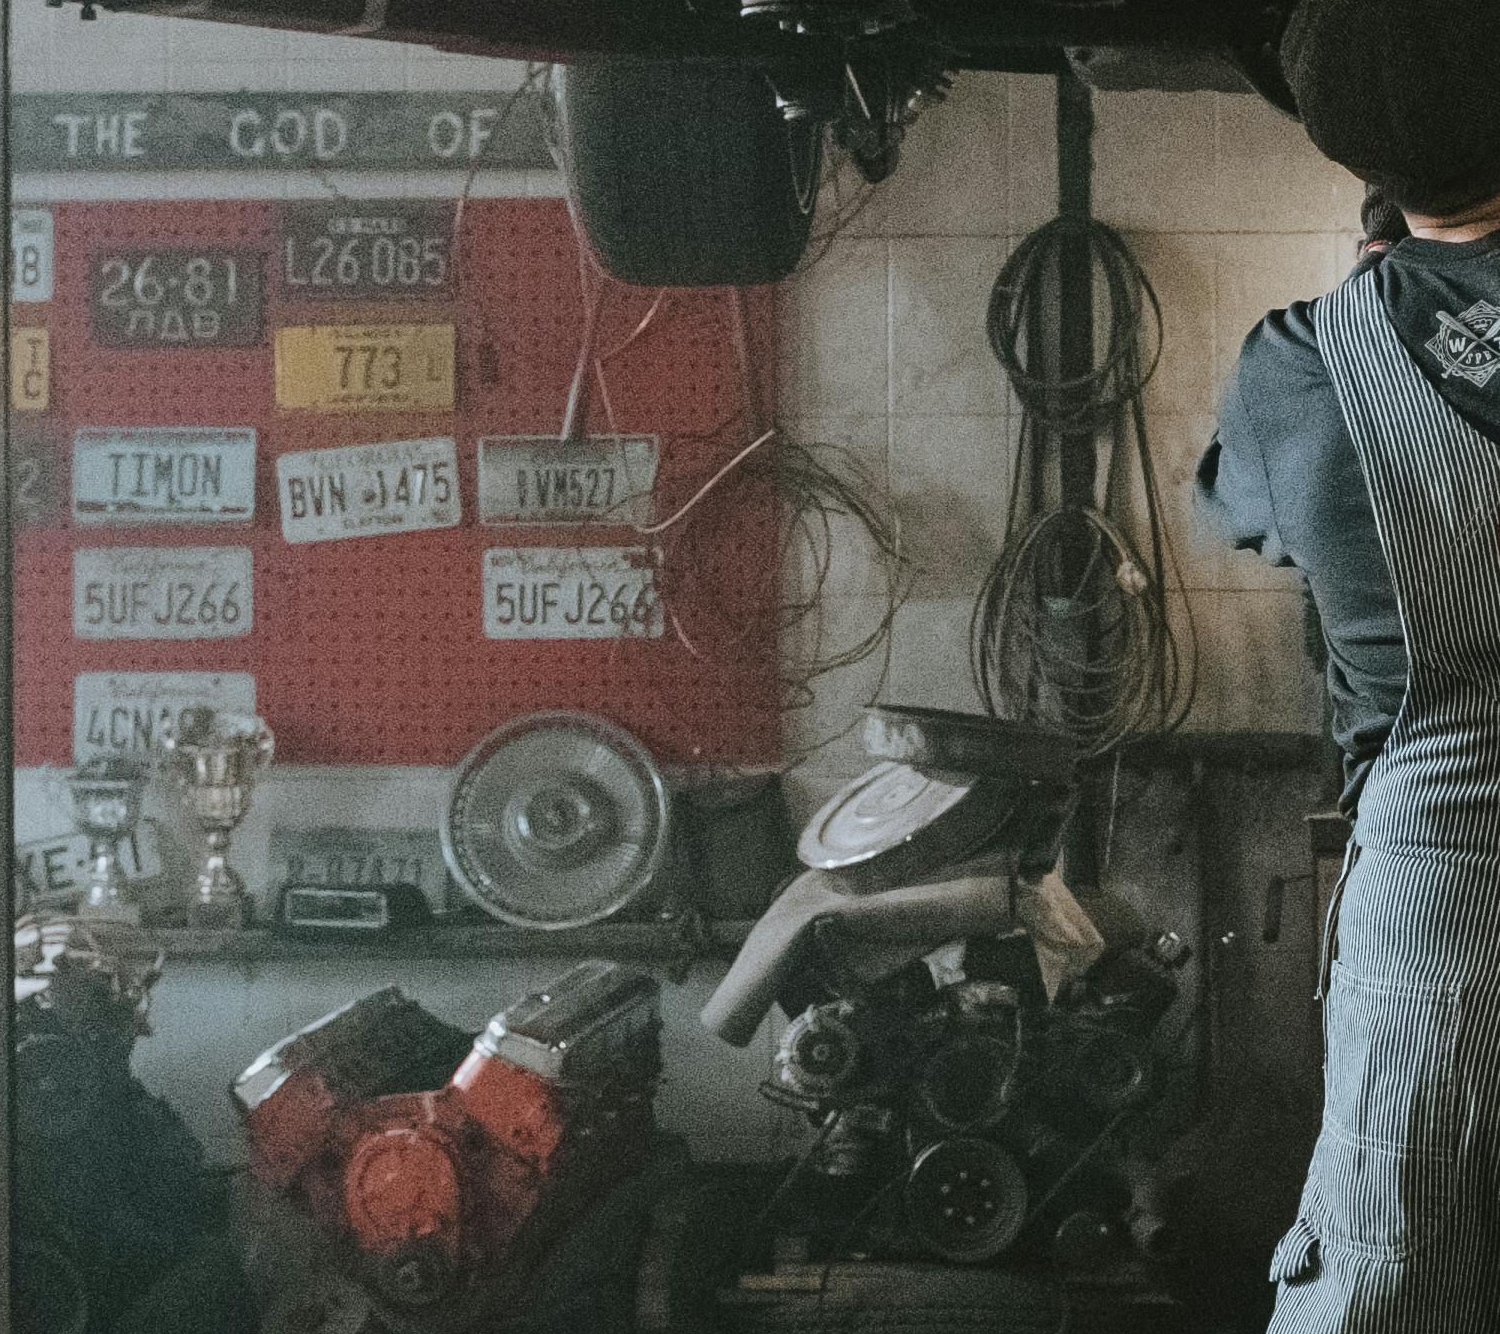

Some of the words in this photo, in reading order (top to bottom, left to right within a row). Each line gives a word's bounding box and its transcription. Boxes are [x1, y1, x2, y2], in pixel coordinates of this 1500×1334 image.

[54, 113, 149, 157] THE
[229, 108, 349, 159] GOD
[426, 108, 499, 159] OF
[334, 345, 403, 390] 773
[1448, 336, 1467, 354] W
[108, 452, 223, 497] TIMON
[288, 471, 347, 519] BVN
[376, 461, 452, 509] 1475
